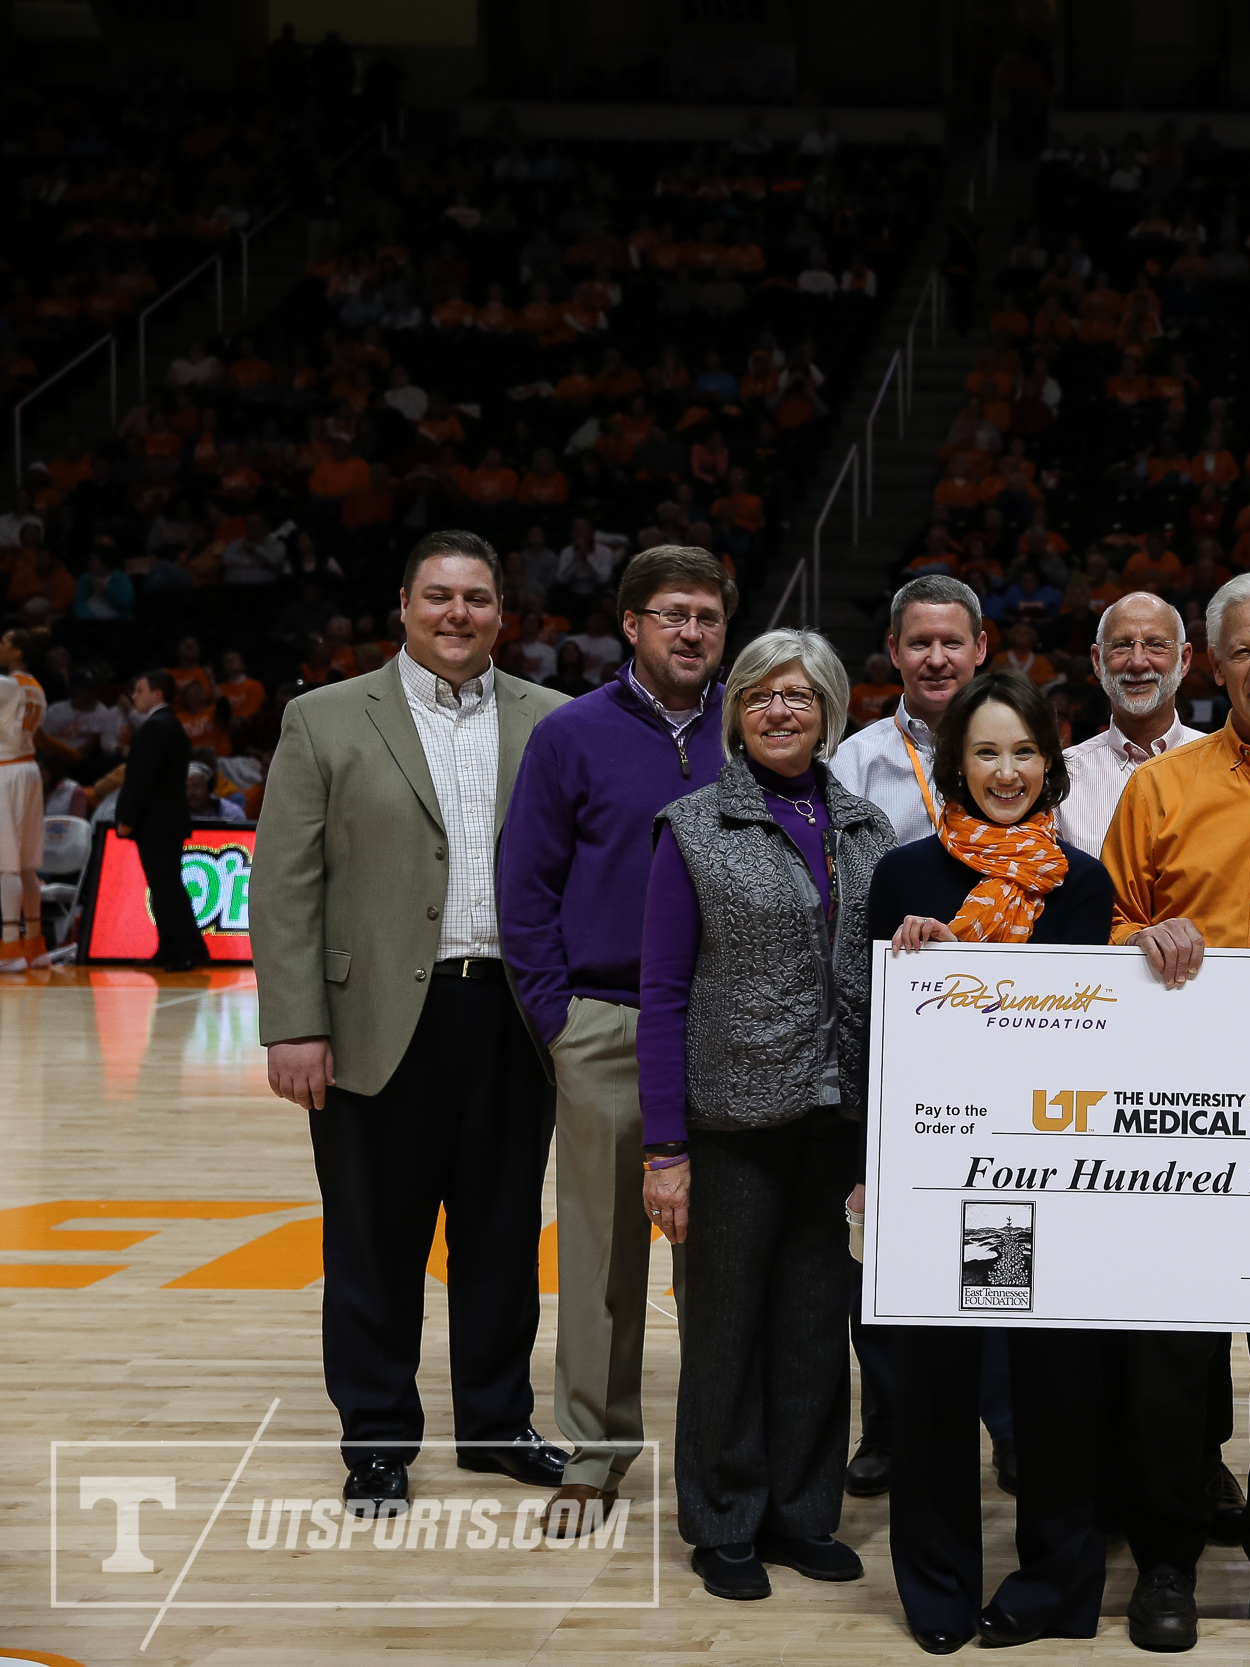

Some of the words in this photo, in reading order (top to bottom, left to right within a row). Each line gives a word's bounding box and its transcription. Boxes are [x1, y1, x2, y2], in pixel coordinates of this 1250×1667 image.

[910, 981, 944, 992] THE
[986, 1017, 1107, 1030] FOUNDATION
[1113, 1091, 1144, 1106] THE
[1149, 1092, 1246, 1108] UNIVERSITY
[915, 1103, 942, 1118] Pay
[946, 1105, 960, 1116] to
[964, 1104, 988, 1116] the
[914, 1121, 957, 1134] Order
[960, 1122, 975, 1135] of
[1112, 1109, 1246, 1136] MEDICAL
[961, 1156, 1058, 1189] Four
[1066, 1158, 1236, 1193] Hundred
[964, 1287, 982, 1296] East
[983, 1287, 1029, 1298] Tennessee
[964, 1297, 1029, 1306] FOUNDATION
